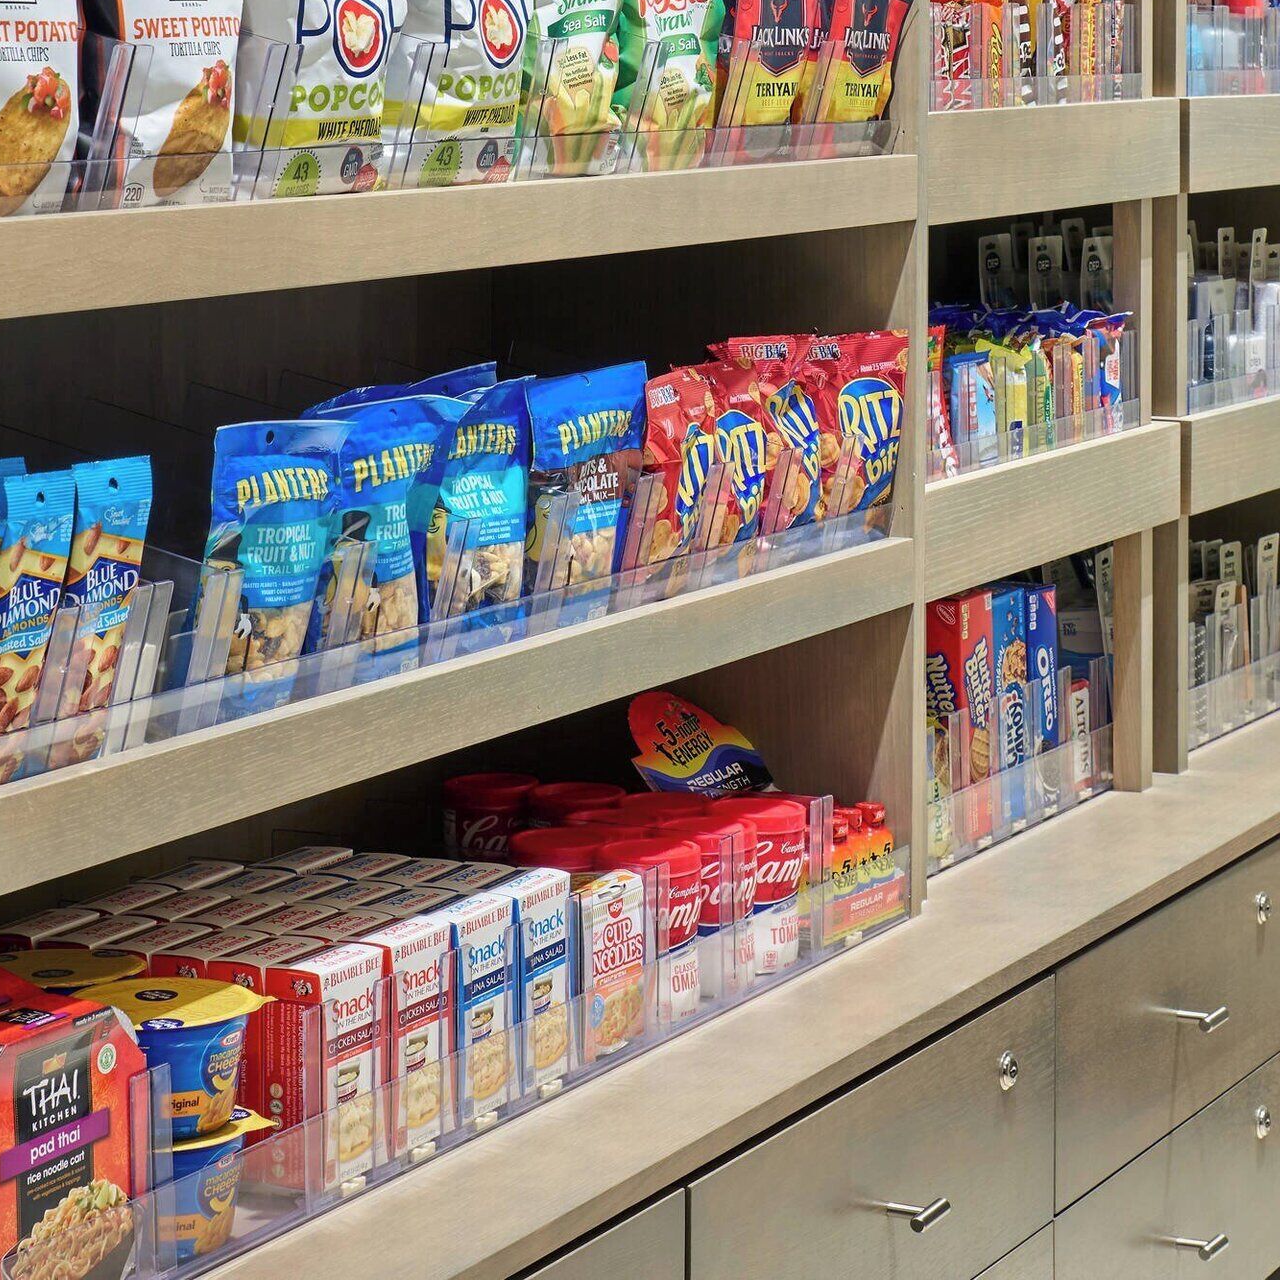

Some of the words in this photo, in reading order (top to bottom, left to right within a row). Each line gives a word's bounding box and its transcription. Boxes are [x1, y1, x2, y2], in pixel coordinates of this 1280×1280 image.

[15, 20, 78, 42] POTATO
[134, 18, 188, 39] SWEET
[562, 20, 582, 33] Sea
[585, 15, 605, 29] Salt
[27, 47, 49, 61] CHIPS
[170, 42, 201, 56] TORTILLA
[203, 42, 221, 55] CHIPS
[678, 37, 696, 52] Salt
[566, 53, 578, 61] Less
[756, 82, 798, 96] TERIYAK
[318, 119, 348, 141] WHITE
[437, 149, 453, 166] 43
[292, 160, 309, 182] 43
[124, 187, 141, 202] 220
[740, 345, 764, 359] BIG
[838, 391, 901, 453] RITZ
[597, 458, 607, 472] &
[595, 491, 608, 502] MIX
[258, 525, 311, 544] TROPICAL
[248, 547, 286, 563] FRUIT
[291, 547, 298, 560] &
[299, 542, 316, 558] NUT
[86, 562, 118, 591] BLUE
[262, 565, 291, 575] TRAIL
[9, 580, 43, 609] BLUE
[65, 570, 138, 606] DIAMOND
[2, 615, 48, 637] ALMONDS
[965, 658, 985, 728] Butter
[1037, 648, 1051, 730] OREO
[1075, 696, 1089, 775] ALTOIDS
[672, 730, 714, 768] ENERGY
[526, 887, 555, 909] BUMBLE
[555, 881, 567, 893] BEE
[851, 892, 883, 911] REGULAR
[466, 913, 497, 934] BUMBLE
[497, 906, 510, 920] BEE
[529, 909, 564, 941] Snack
[400, 936, 433, 958] BUMBLE
[434, 930, 446, 943] BEE
[603, 918, 632, 948] CUP
[771, 924, 798, 944] TOMA
[470, 935, 505, 966] Snack
[545, 944, 564, 959] SALAD
[593, 934, 643, 977] NOODLES
[331, 961, 367, 986] BUMBLE
[368, 956, 379, 970] BEE
[402, 960, 440, 993] Snack
[486, 972, 505, 986] SALAD
[332, 988, 373, 1022] Snack
[22, 1069, 79, 1116] THAI
[171, 1097, 199, 1110] riginal
[32, 1106, 77, 1131] KITCHEN
[30, 1133, 56, 1164] pad
[58, 1126, 81, 1152] thai
[27, 1170, 41, 1184] rice
[43, 1159, 67, 1179] noodle
[68, 1151, 85, 1169] cart
